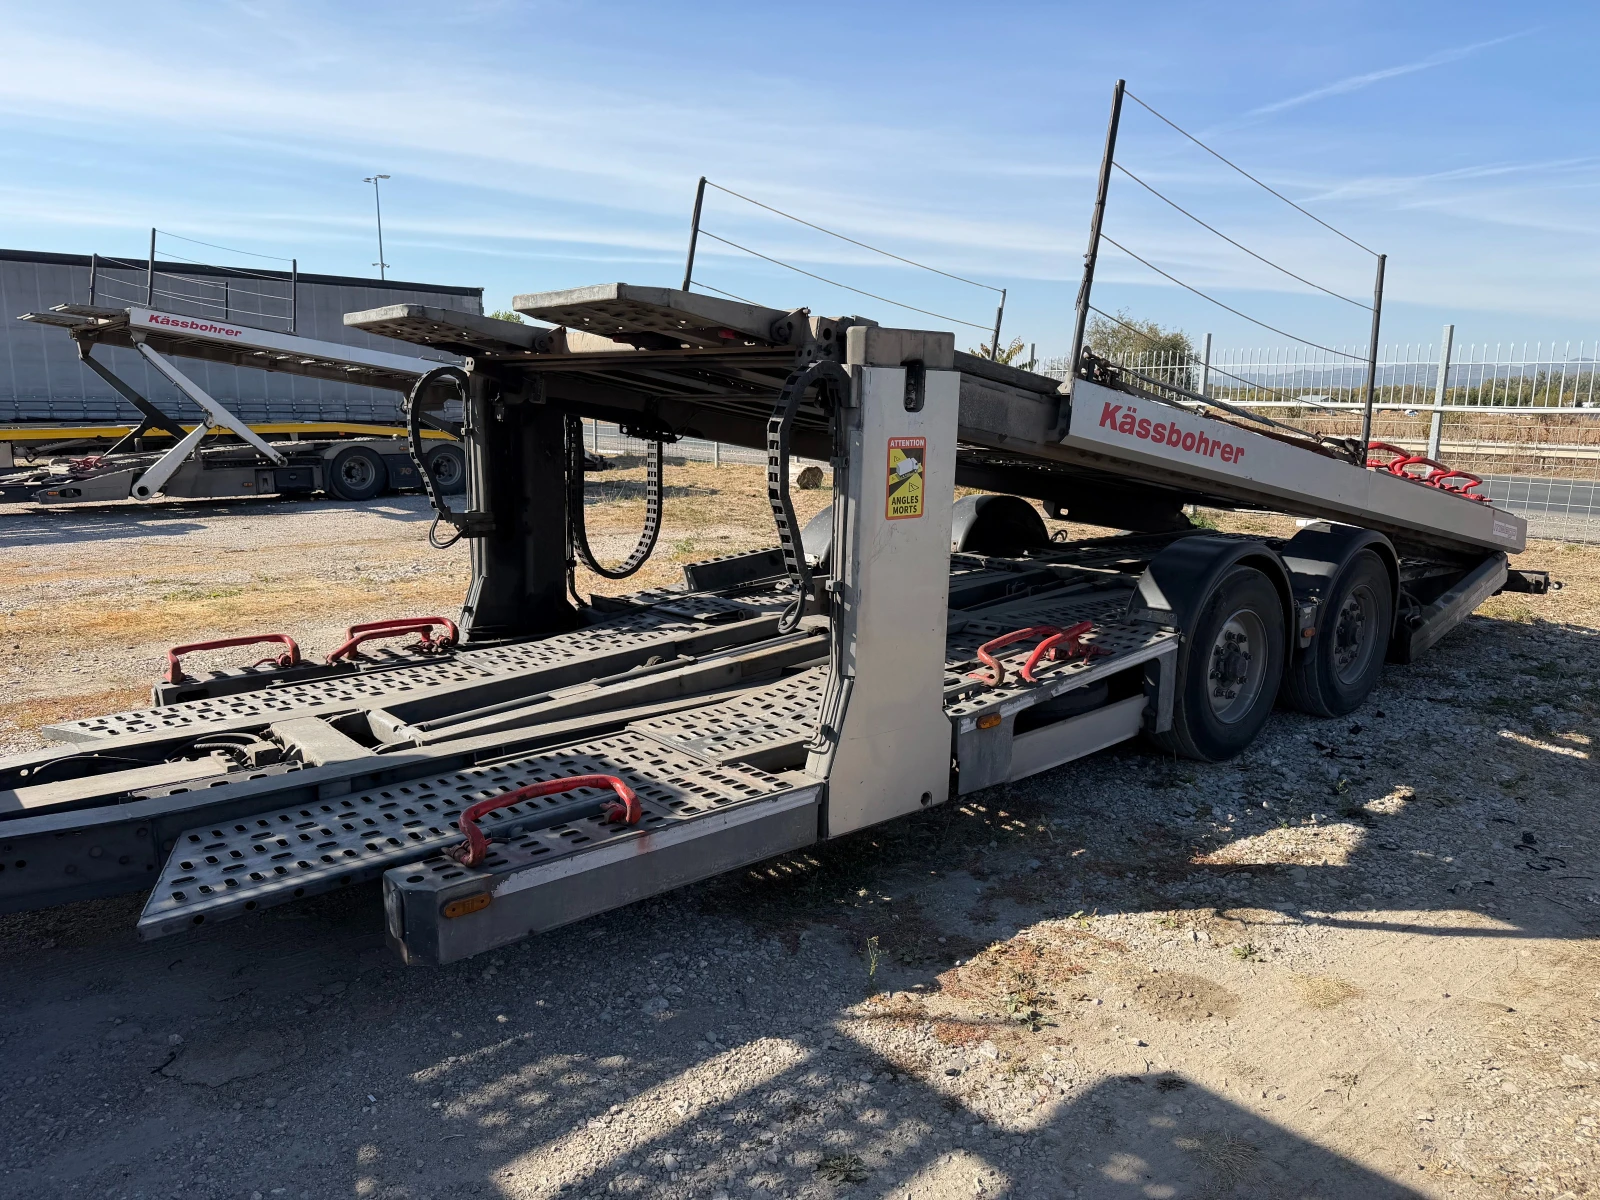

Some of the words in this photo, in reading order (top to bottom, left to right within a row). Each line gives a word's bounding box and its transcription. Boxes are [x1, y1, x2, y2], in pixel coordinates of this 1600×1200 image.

[148, 314, 242, 337] Kässbohrer
[1099, 401, 1245, 464] Kässbohrer
[890, 439, 925, 447] ATTENTION
[891, 495, 919, 506] ANGLES
[892, 505, 918, 515] MORTS
